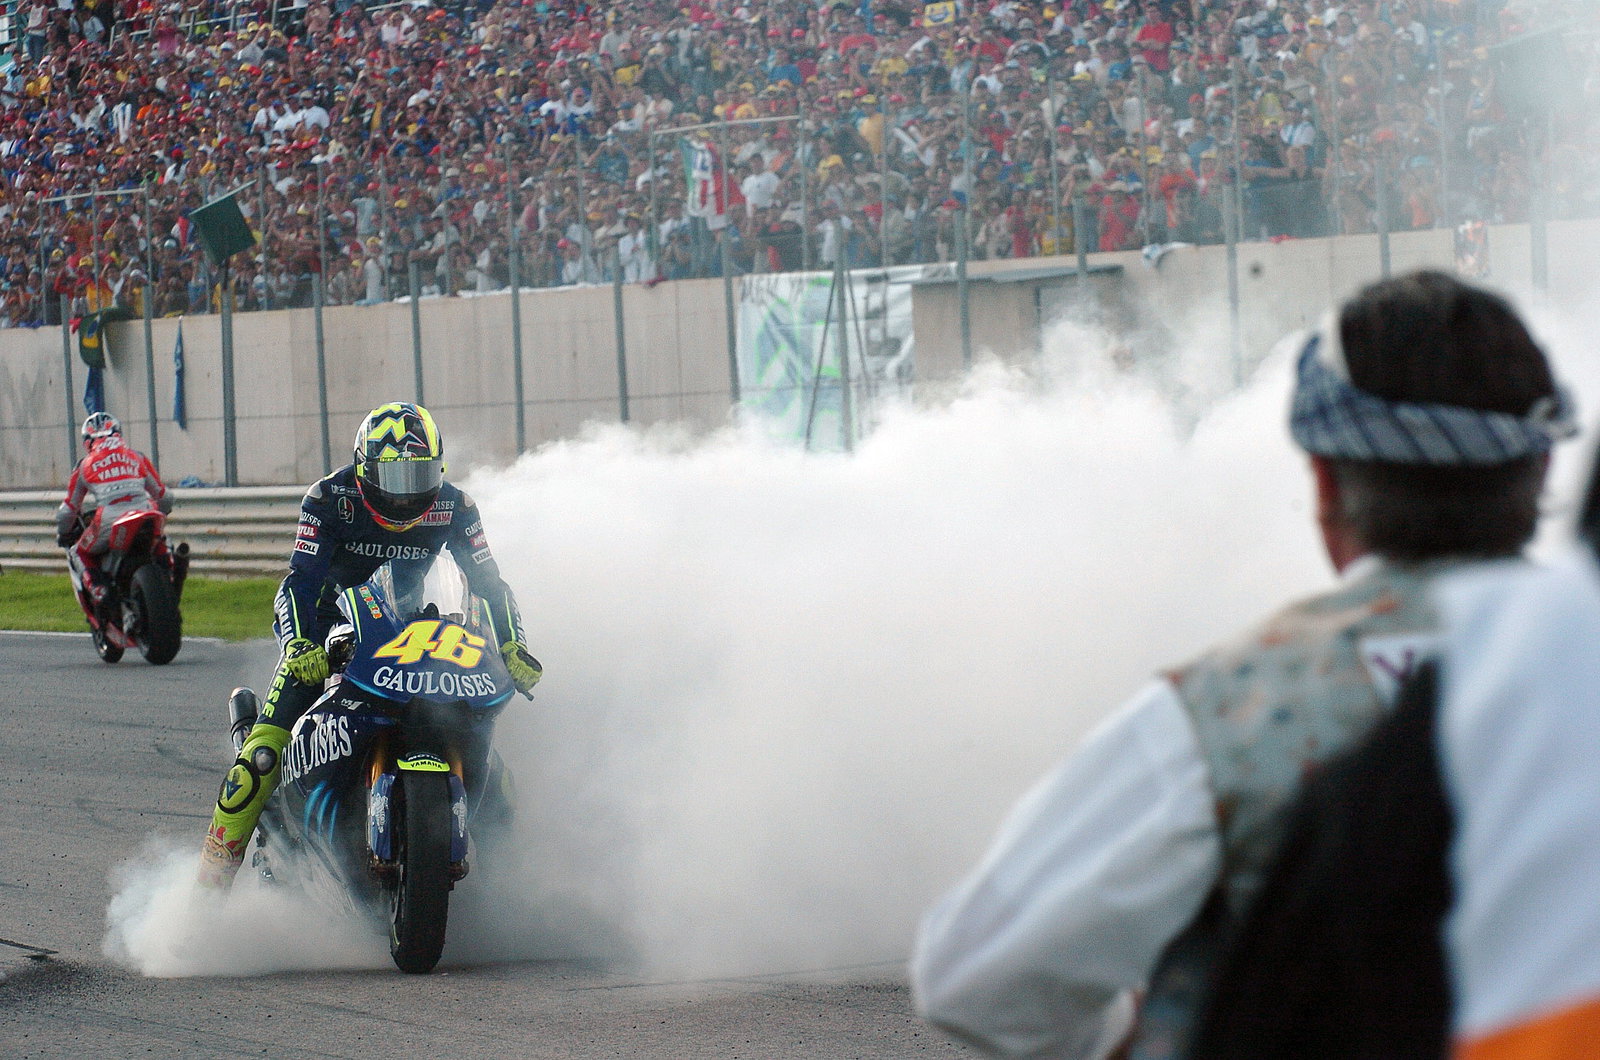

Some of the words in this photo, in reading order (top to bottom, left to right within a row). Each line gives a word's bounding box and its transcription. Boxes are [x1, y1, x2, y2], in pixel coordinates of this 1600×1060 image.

[300, 511, 322, 527] OISES
[345, 541, 430, 560] GAULOISES
[371, 619, 486, 669] 46
[373, 665, 497, 697] GAULOISES
[410, 760, 442, 770] YAMAHA
